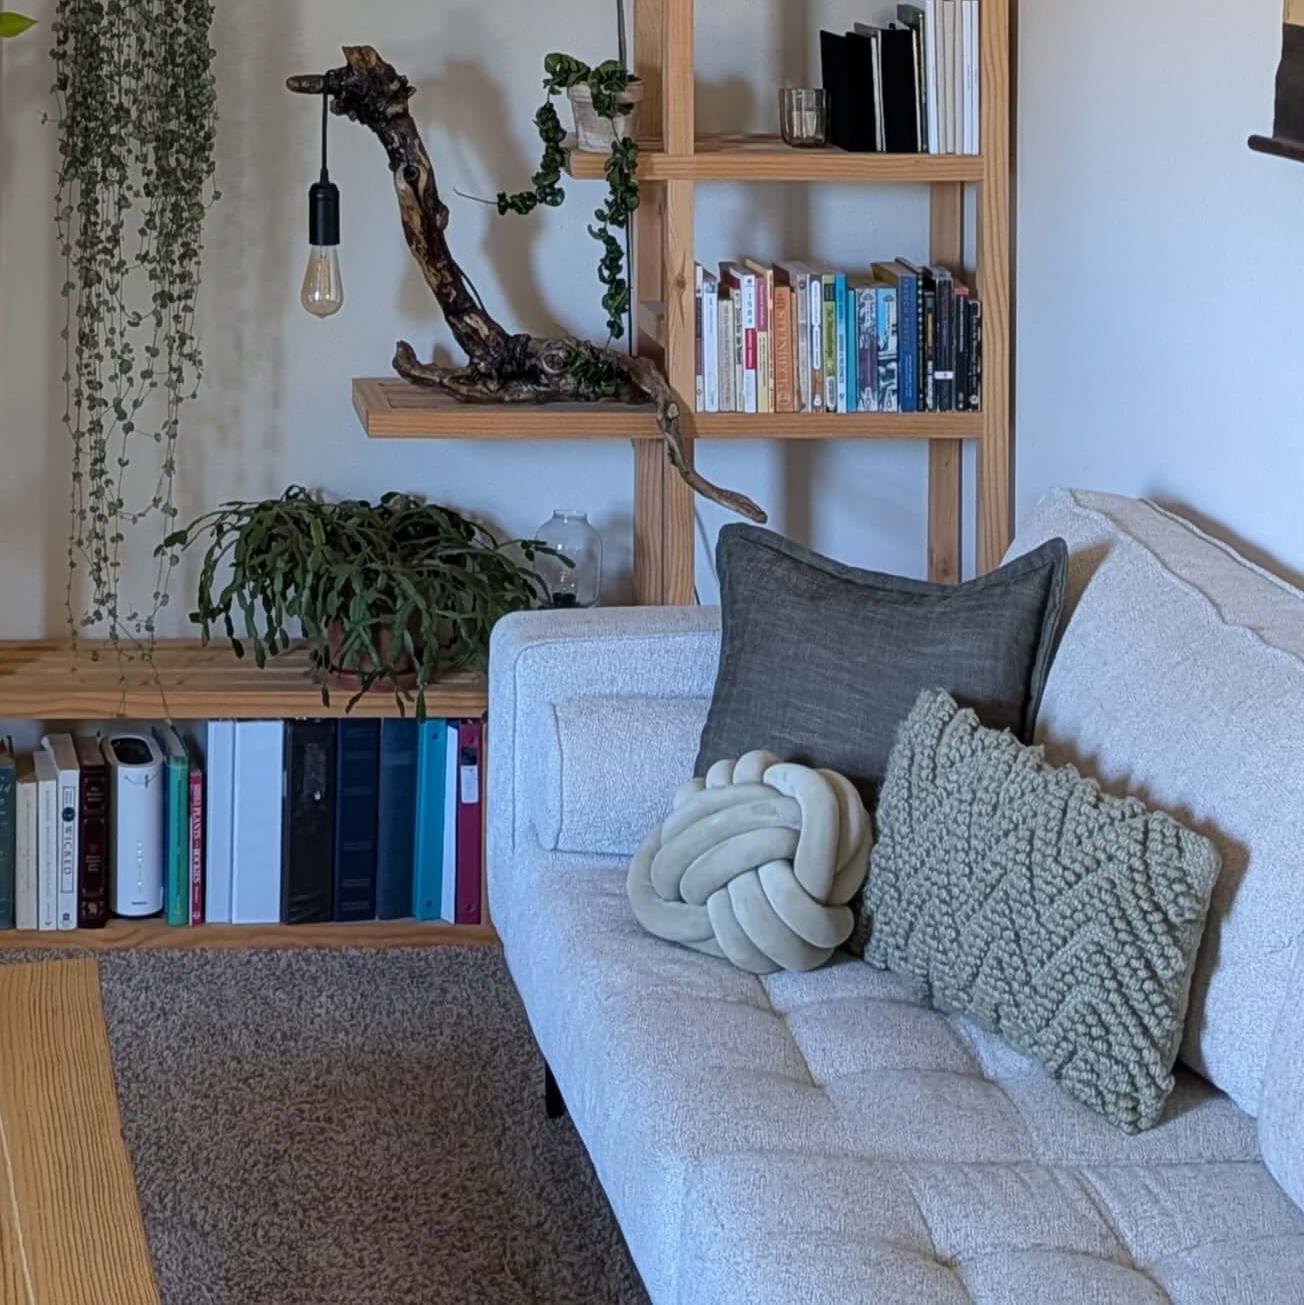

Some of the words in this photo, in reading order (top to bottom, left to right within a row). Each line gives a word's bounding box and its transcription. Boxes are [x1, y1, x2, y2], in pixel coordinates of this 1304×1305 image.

[776, 310, 789, 389] STEINBECK
[192, 807, 201, 840] PLANTS
[63, 825, 74, 875] WICKED
